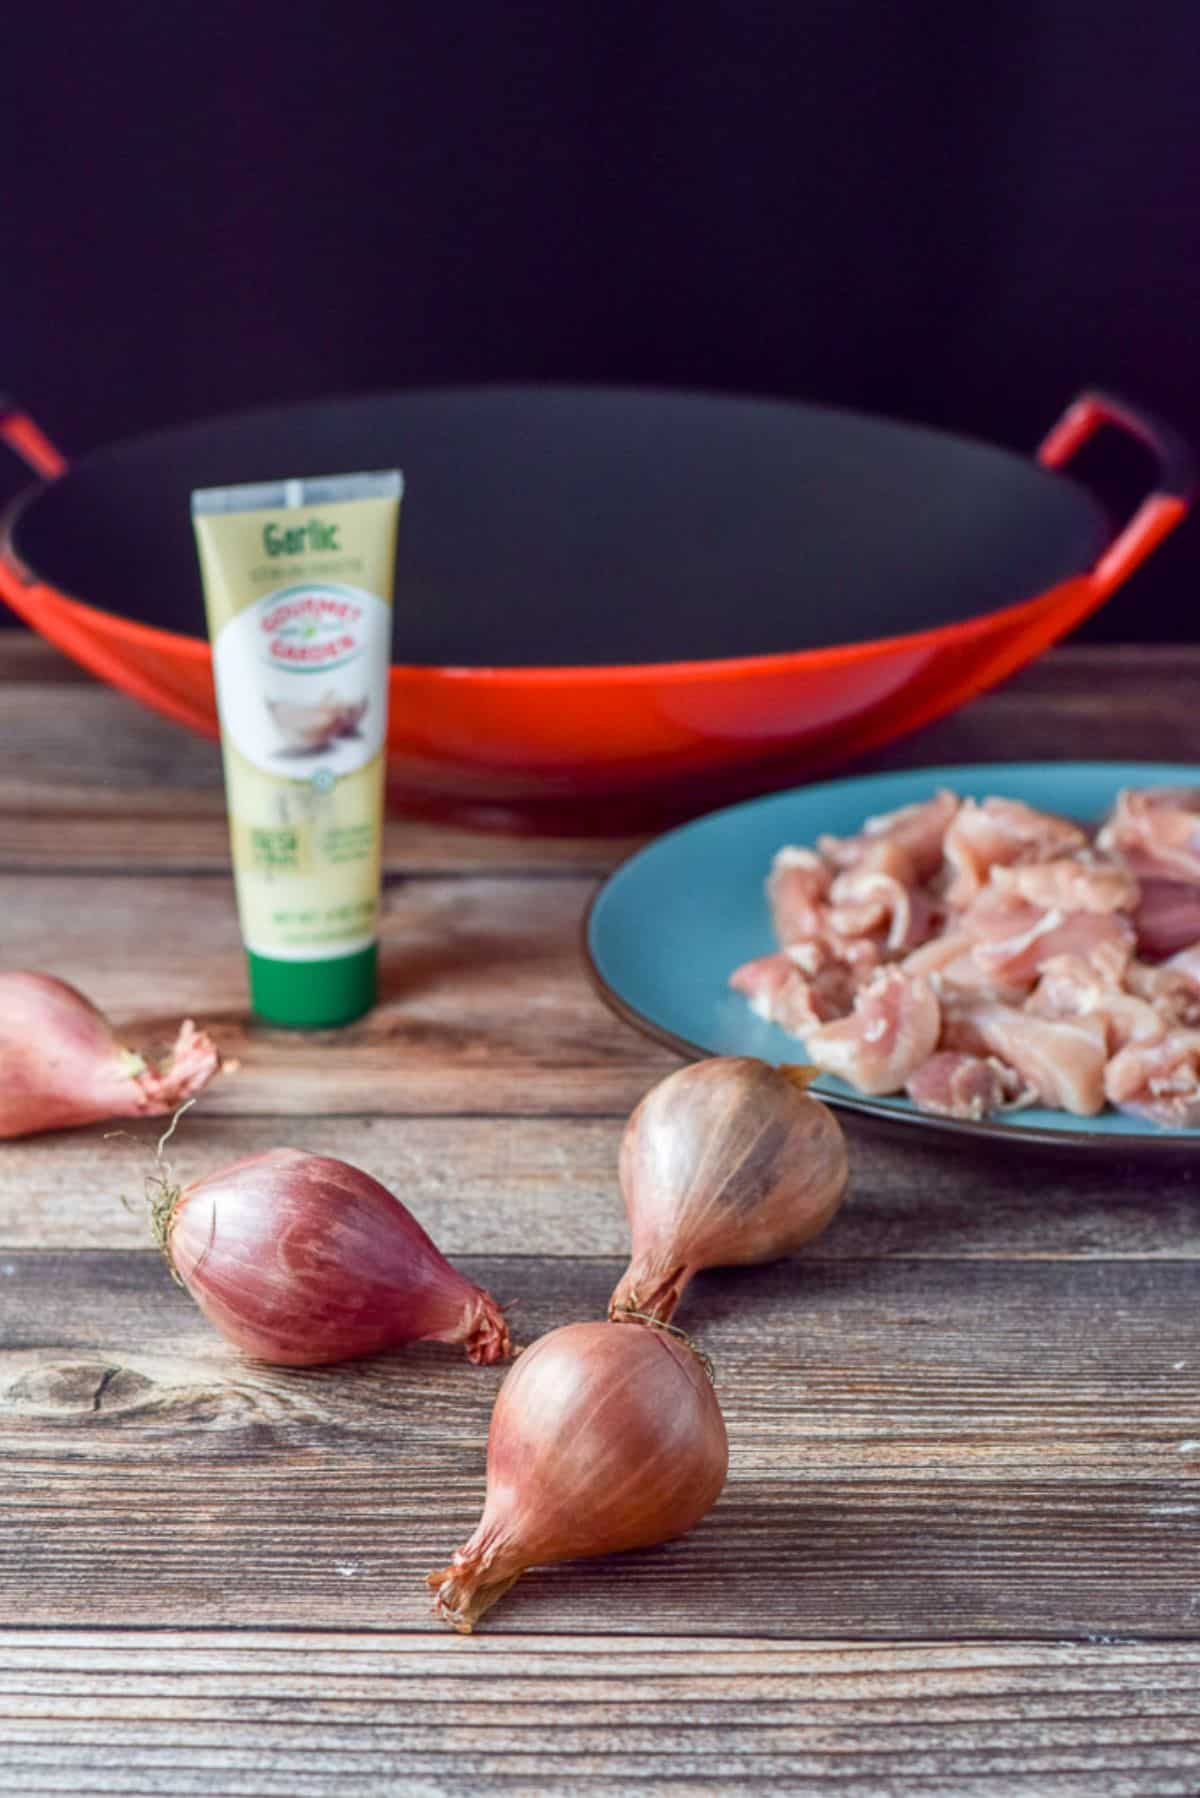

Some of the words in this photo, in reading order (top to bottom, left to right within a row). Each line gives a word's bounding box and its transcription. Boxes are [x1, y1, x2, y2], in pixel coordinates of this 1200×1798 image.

[262, 519, 341, 557] Garlic
[262, 598, 362, 634] GOURMET
[270, 635, 356, 662] GARDEN
